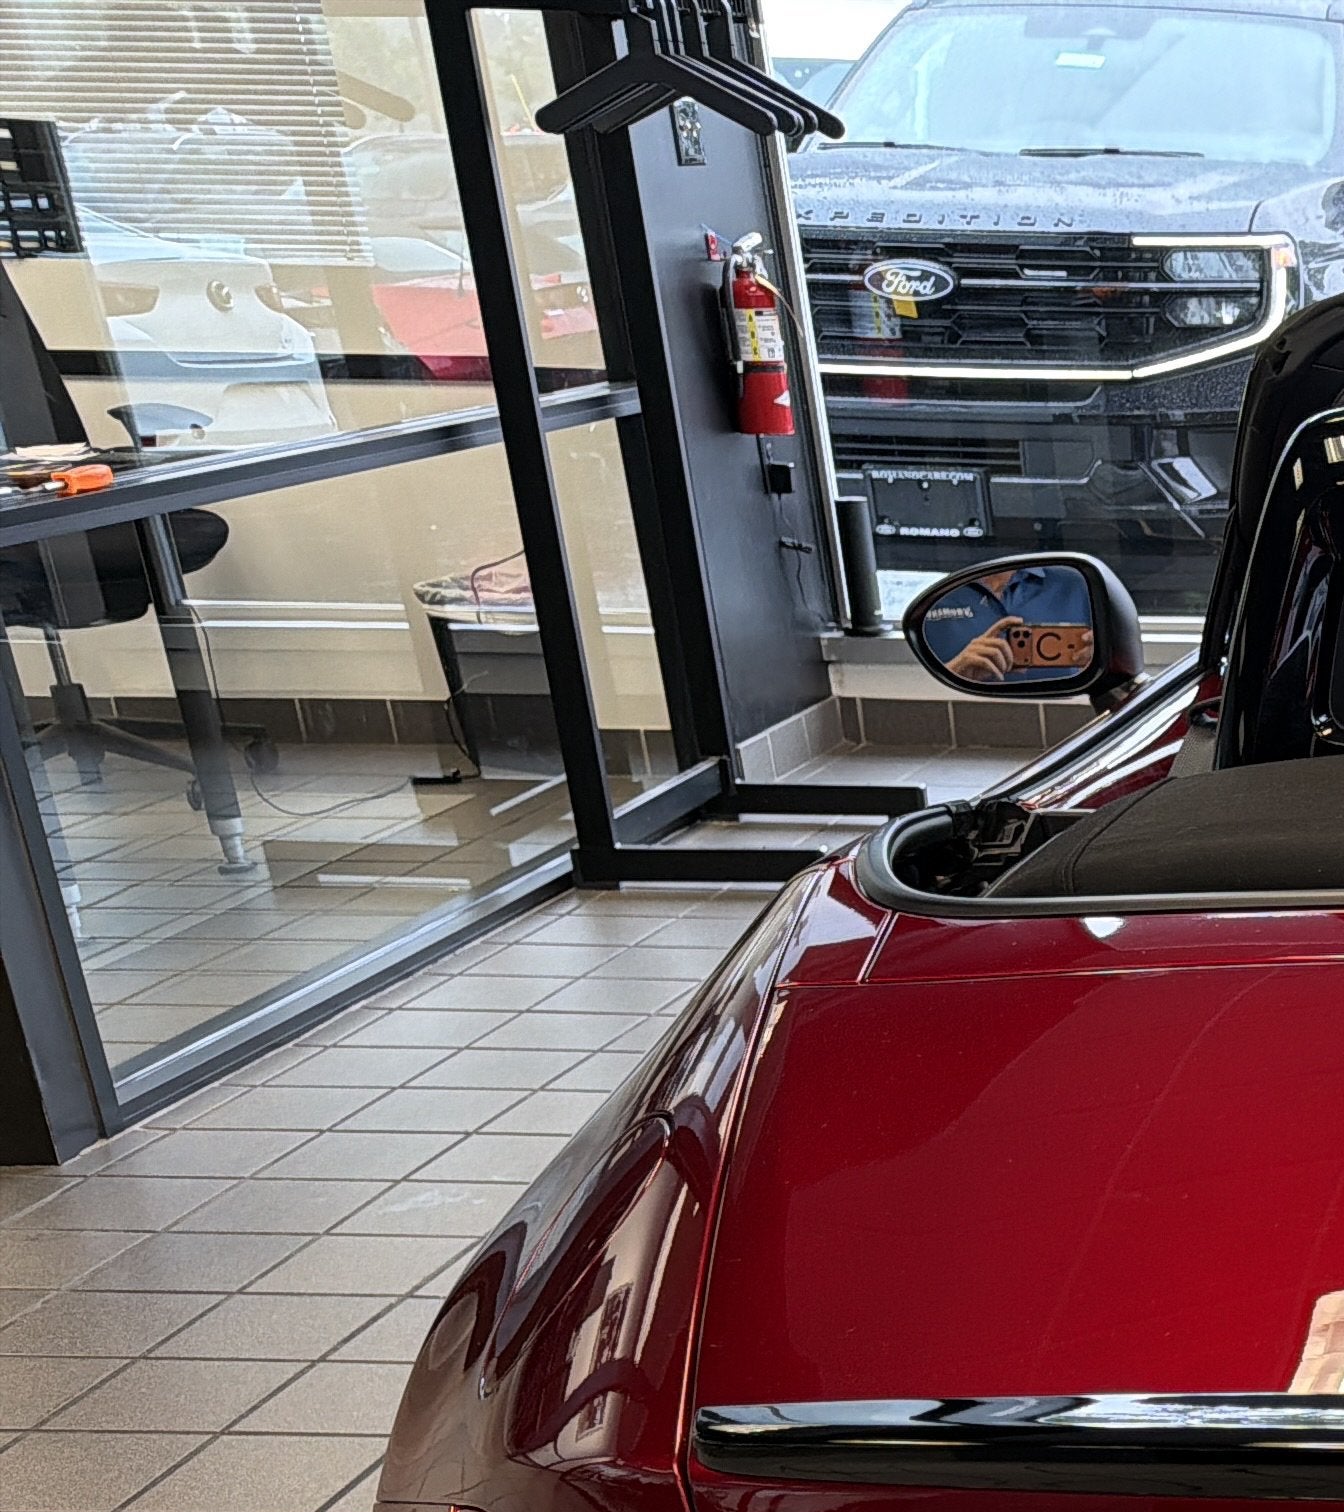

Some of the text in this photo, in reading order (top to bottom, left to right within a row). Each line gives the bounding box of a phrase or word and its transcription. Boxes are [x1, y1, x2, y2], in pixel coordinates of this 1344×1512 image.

[796, 209, 1074, 229] XPEDITION
[881, 267, 936, 295] Ford
[900, 526, 960, 537] ROMANO
